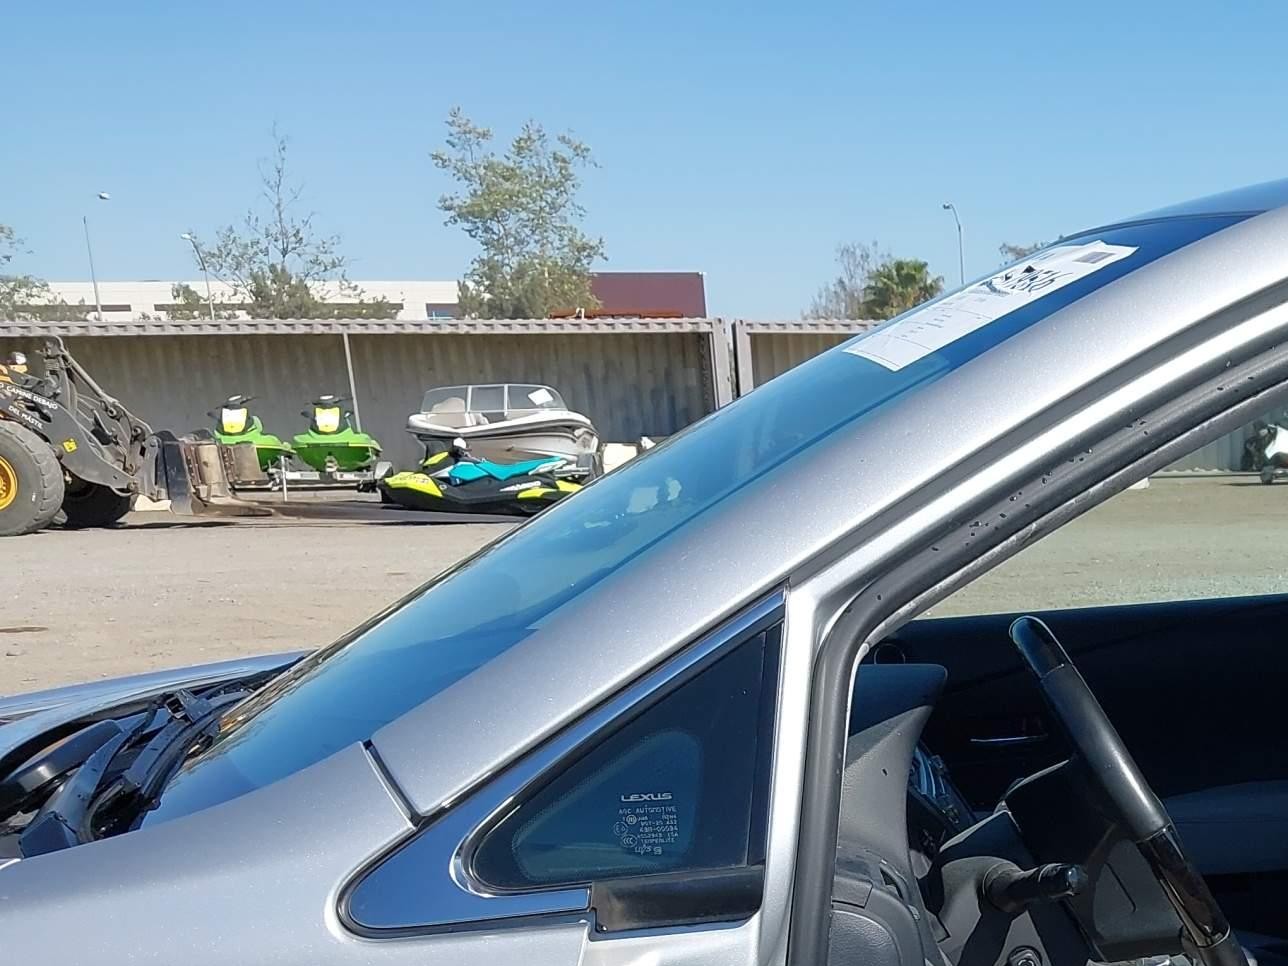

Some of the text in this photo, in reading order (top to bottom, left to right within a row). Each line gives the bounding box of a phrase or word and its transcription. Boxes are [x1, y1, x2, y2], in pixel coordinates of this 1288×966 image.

[6, 385, 33, 400] CAMINE
[32, 395, 59, 410] DEBAJO
[8, 405, 21, 416] DEL
[620, 792, 673, 802] LEXUS
